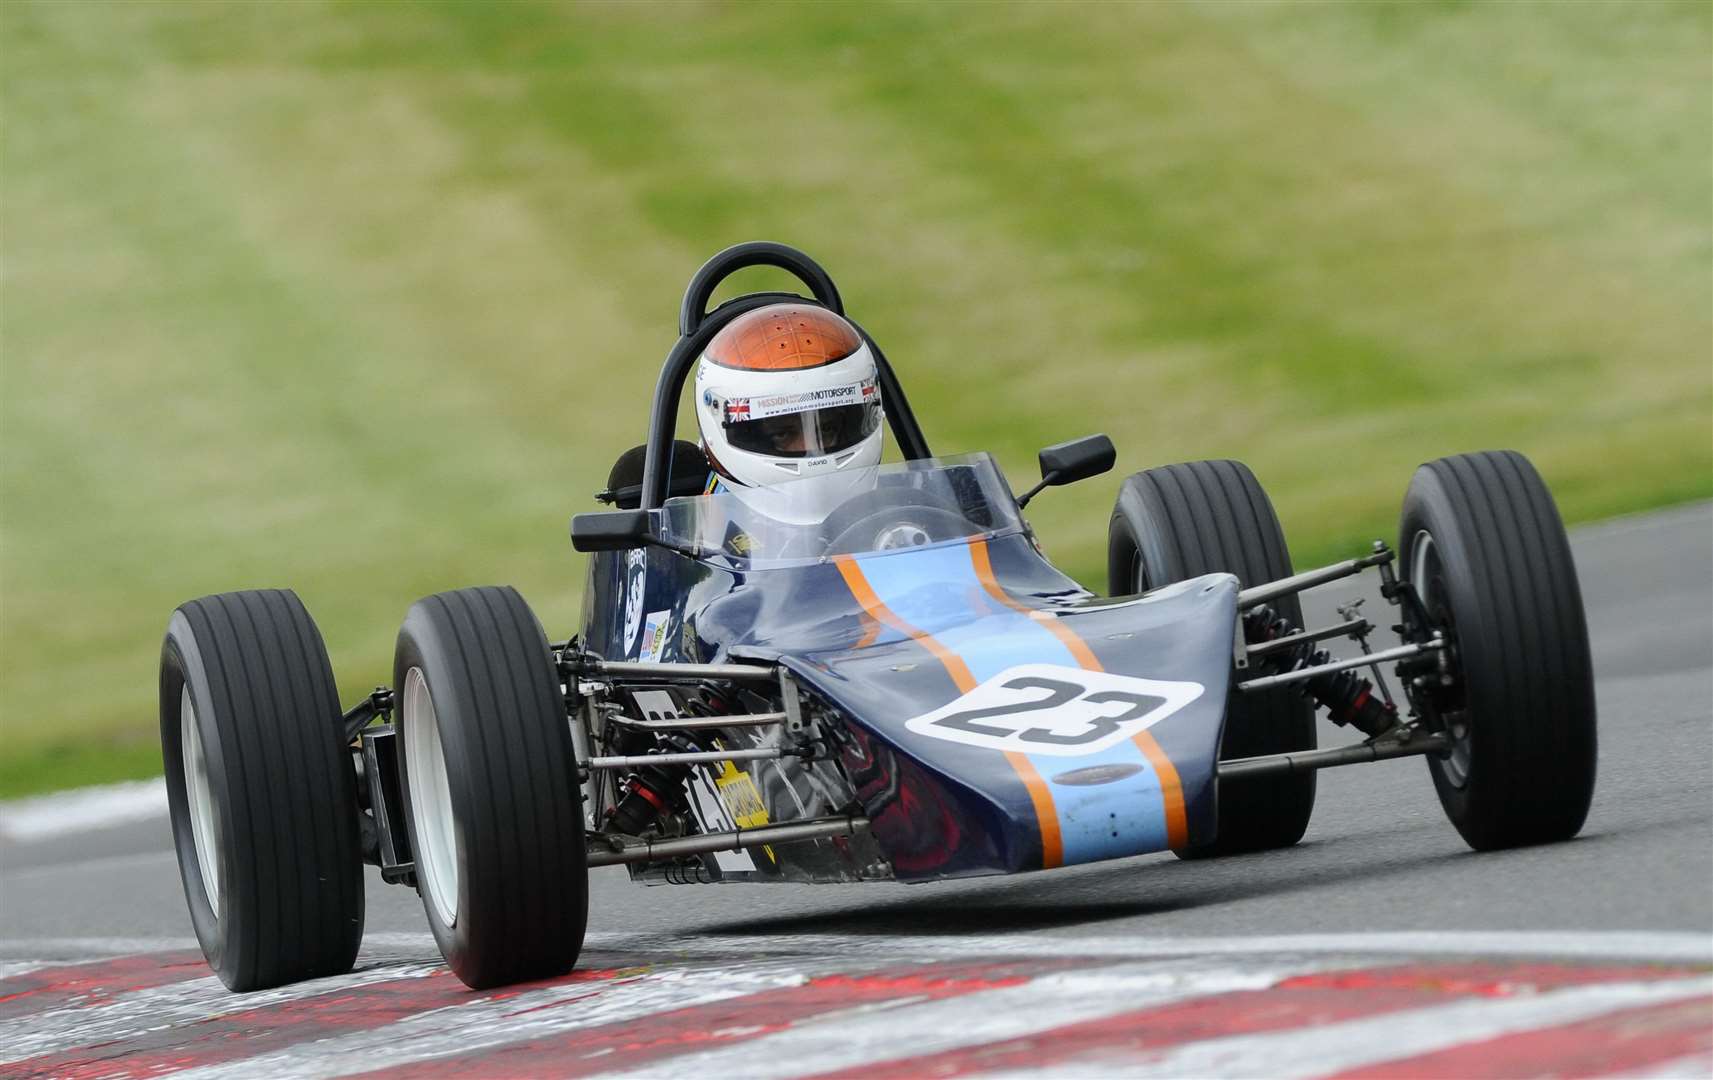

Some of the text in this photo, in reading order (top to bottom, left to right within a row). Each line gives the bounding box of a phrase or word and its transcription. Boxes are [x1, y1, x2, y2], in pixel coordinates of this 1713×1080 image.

[758, 396, 789, 408] MISSION
[810, 386, 856, 400] MOTORSPORT
[765, 399, 854, 415] www.missionmotorsport.org
[808, 459, 828, 467] DAVID
[931, 676, 1167, 746] 23
